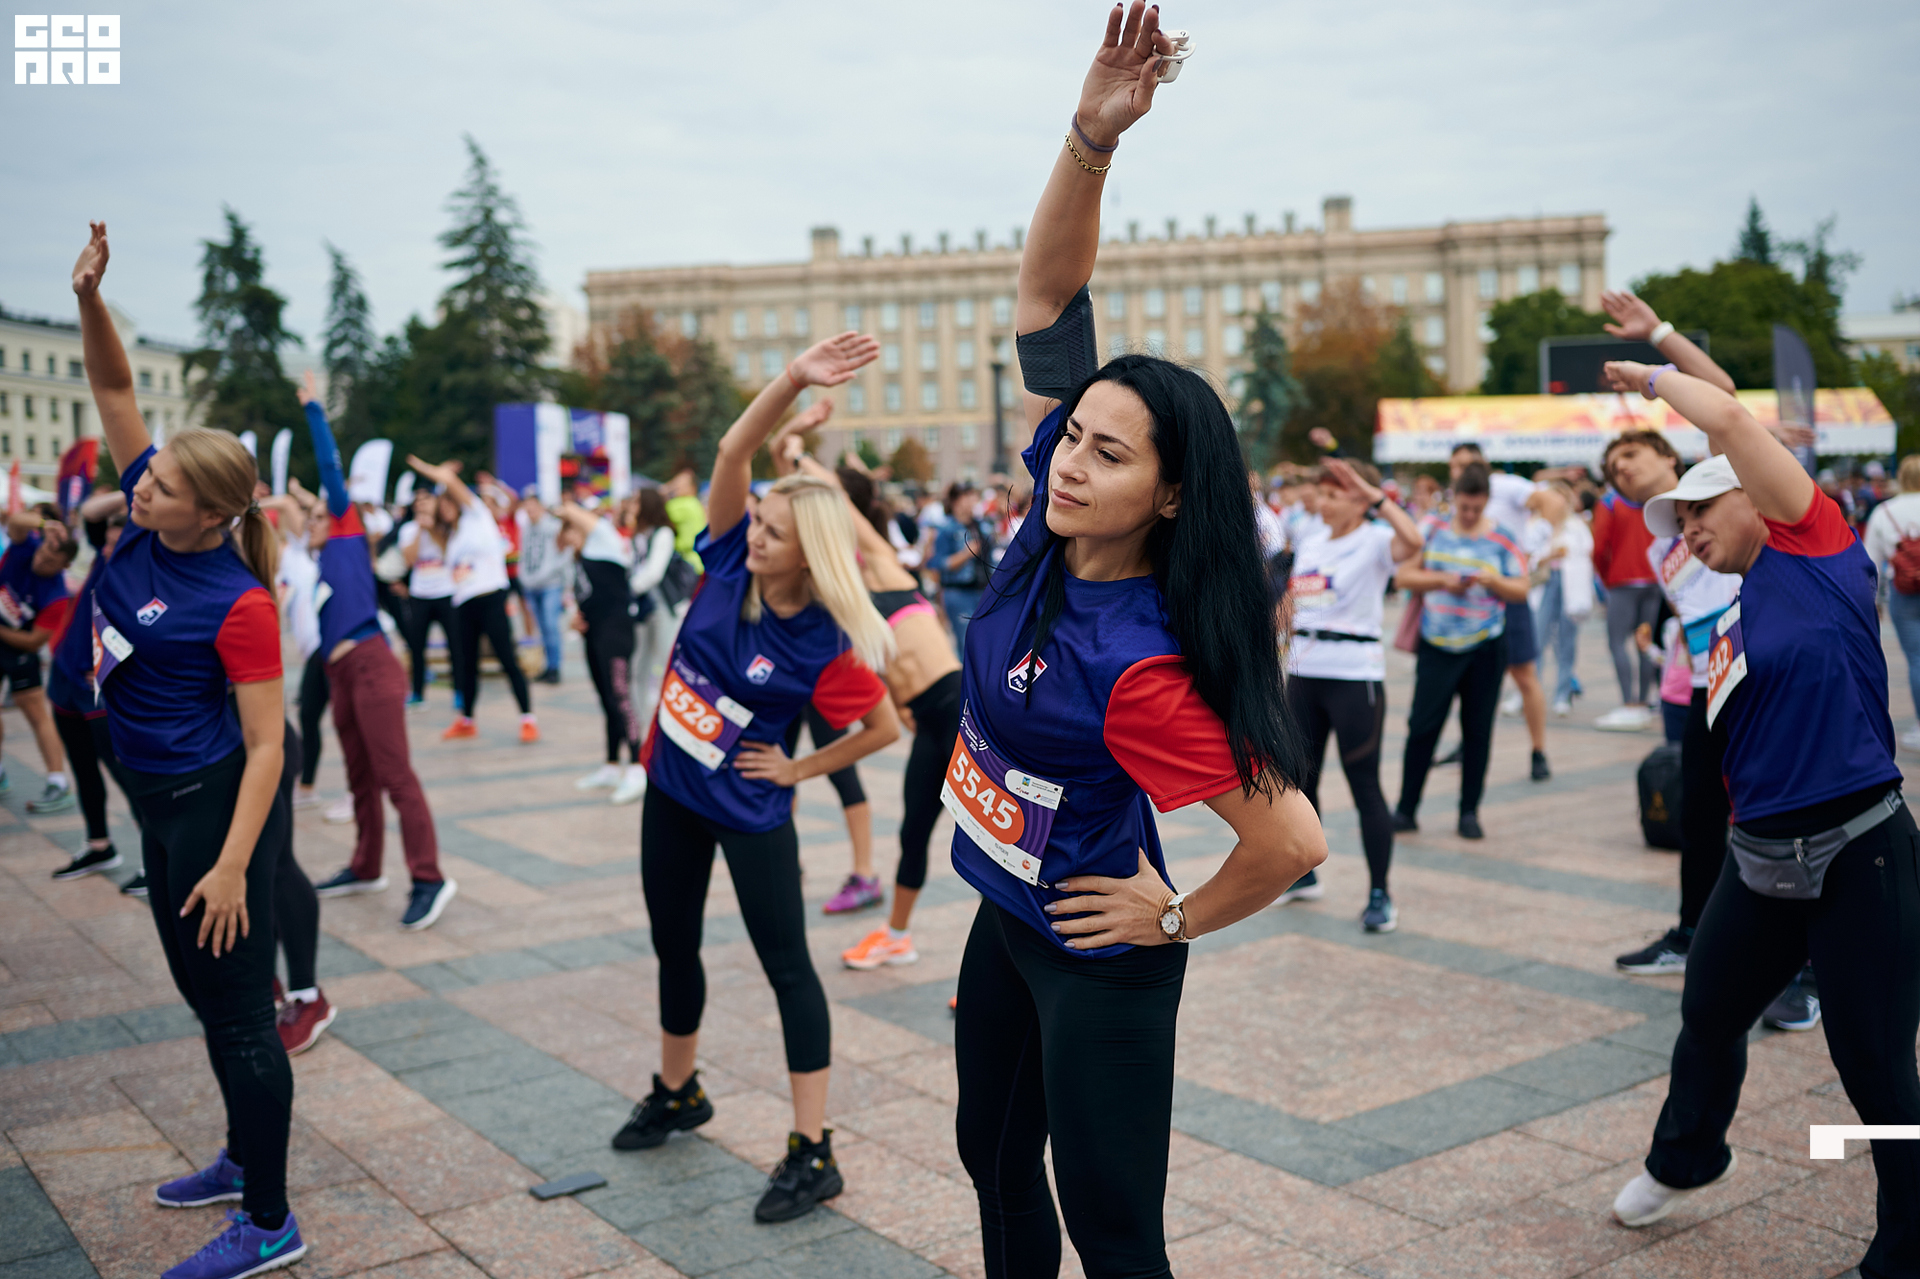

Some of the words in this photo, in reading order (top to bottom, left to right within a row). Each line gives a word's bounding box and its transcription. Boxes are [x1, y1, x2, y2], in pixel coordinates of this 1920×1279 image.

[1708, 640, 1729, 698] 542
[664, 681, 721, 735] 5526
[952, 752, 1018, 829] 5545
